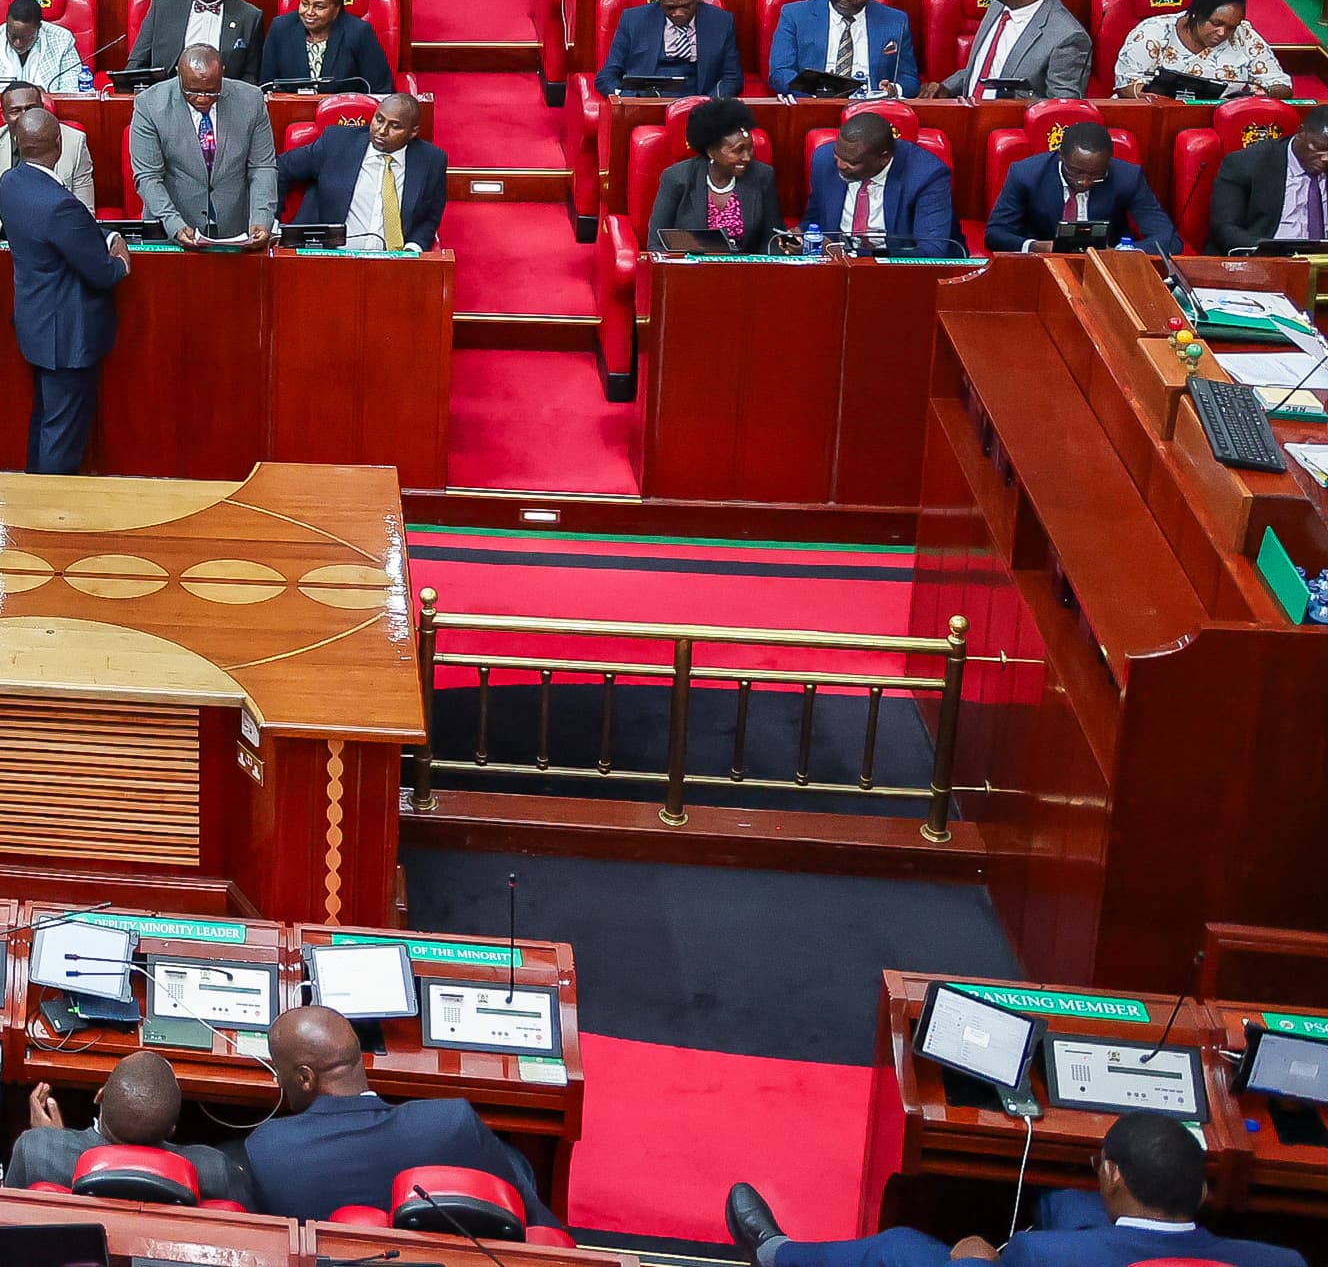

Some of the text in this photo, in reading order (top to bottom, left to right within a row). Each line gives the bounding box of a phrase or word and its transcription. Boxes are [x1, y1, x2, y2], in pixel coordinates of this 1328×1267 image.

[139, 922, 194, 936] MINORITY
[196, 926, 241, 939] LEADER
[412, 946, 429, 955] OF
[430, 947, 455, 957] THE
[1059, 998, 1142, 1017] MEMBER
